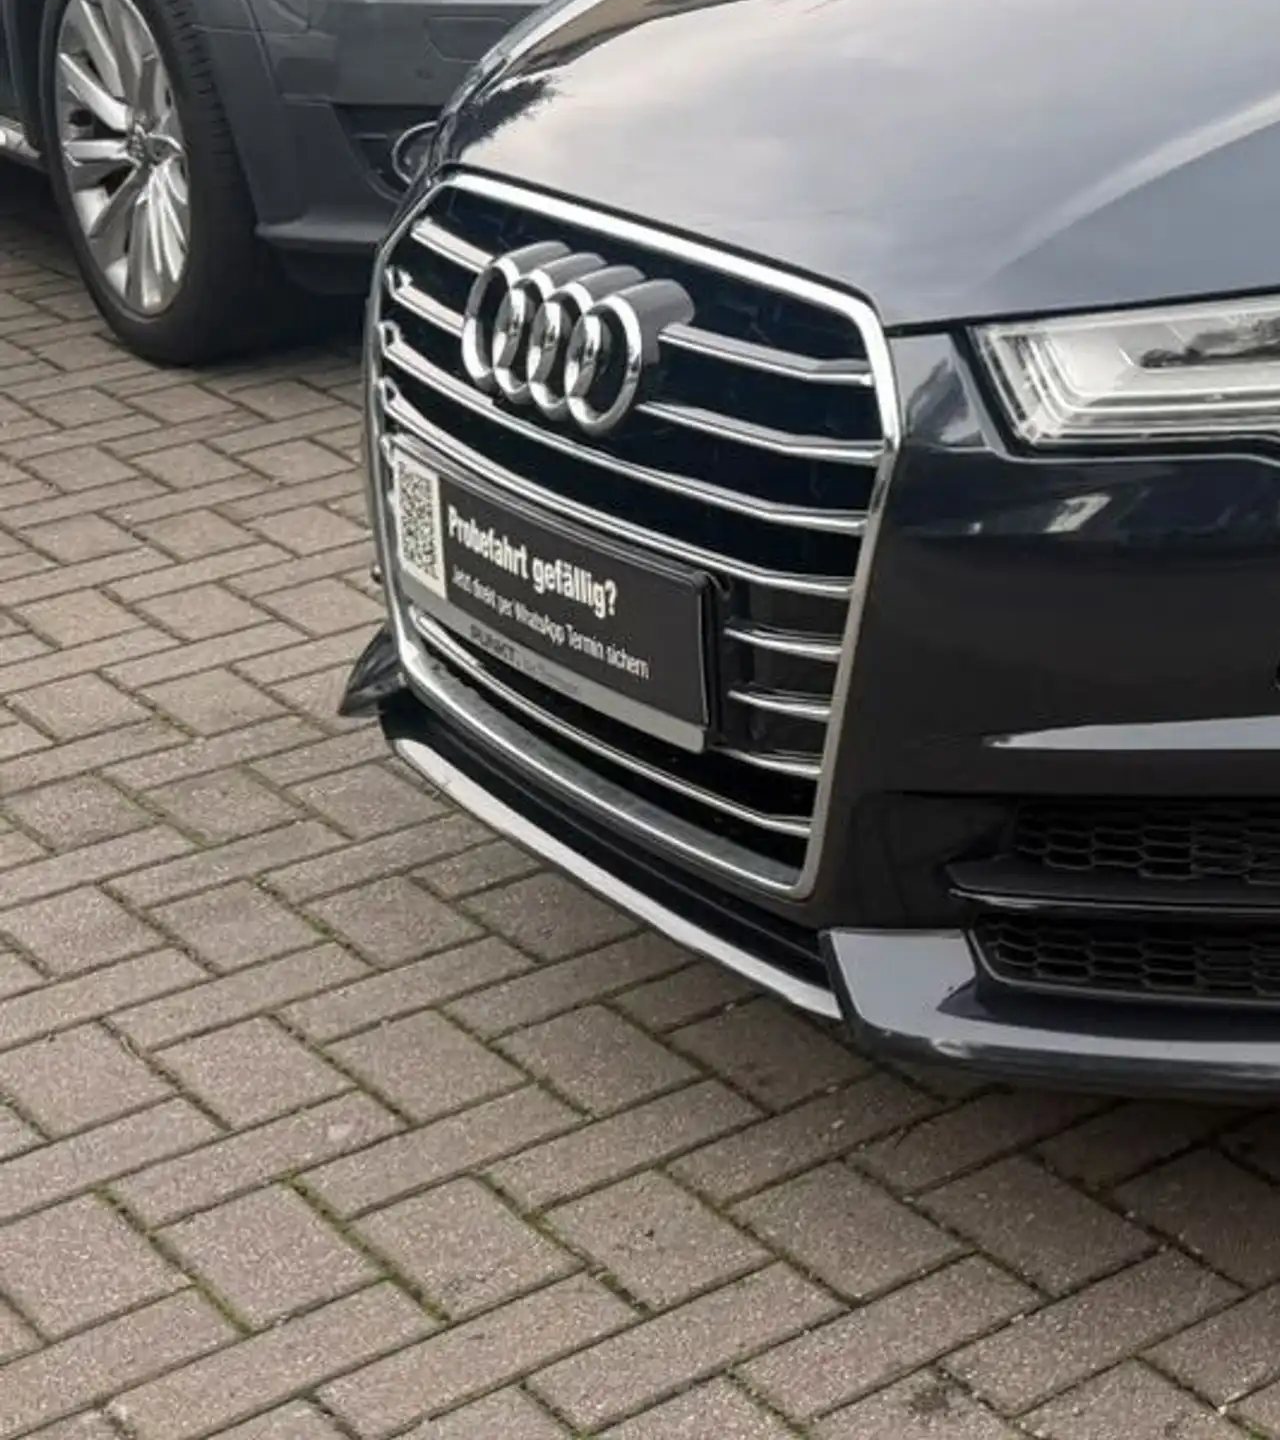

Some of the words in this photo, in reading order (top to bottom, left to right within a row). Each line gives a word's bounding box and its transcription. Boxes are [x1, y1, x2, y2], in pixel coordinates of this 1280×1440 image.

[448, 503, 529, 580] Probefahrt
[532, 557, 618, 619] gefällig?
[565, 623, 604, 661] Termin
[606, 644, 650, 680] sichern
